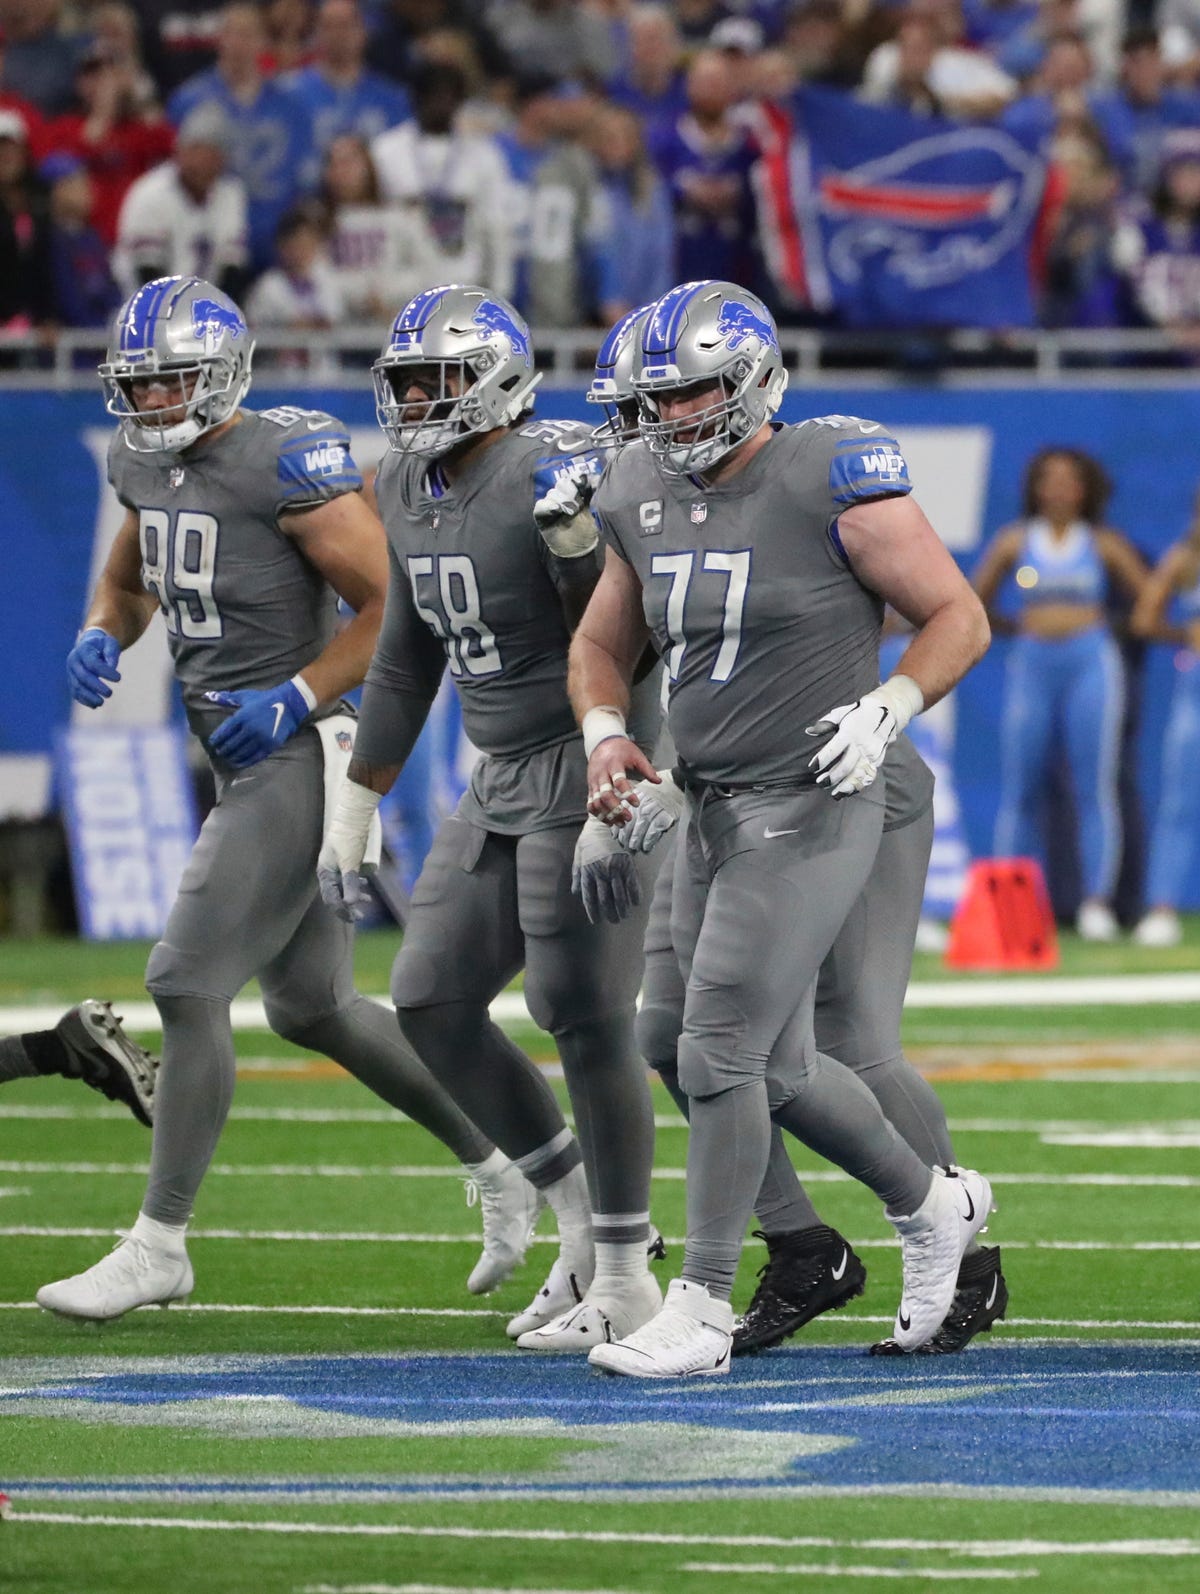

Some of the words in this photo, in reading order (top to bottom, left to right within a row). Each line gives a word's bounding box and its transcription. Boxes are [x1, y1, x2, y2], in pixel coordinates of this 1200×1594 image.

[304, 446, 346, 472] WCF
[861, 454, 906, 474] WCF
[640, 500, 662, 528] C
[140, 506, 224, 639] 89
[408, 554, 504, 677] 58
[650, 547, 753, 682] 77
